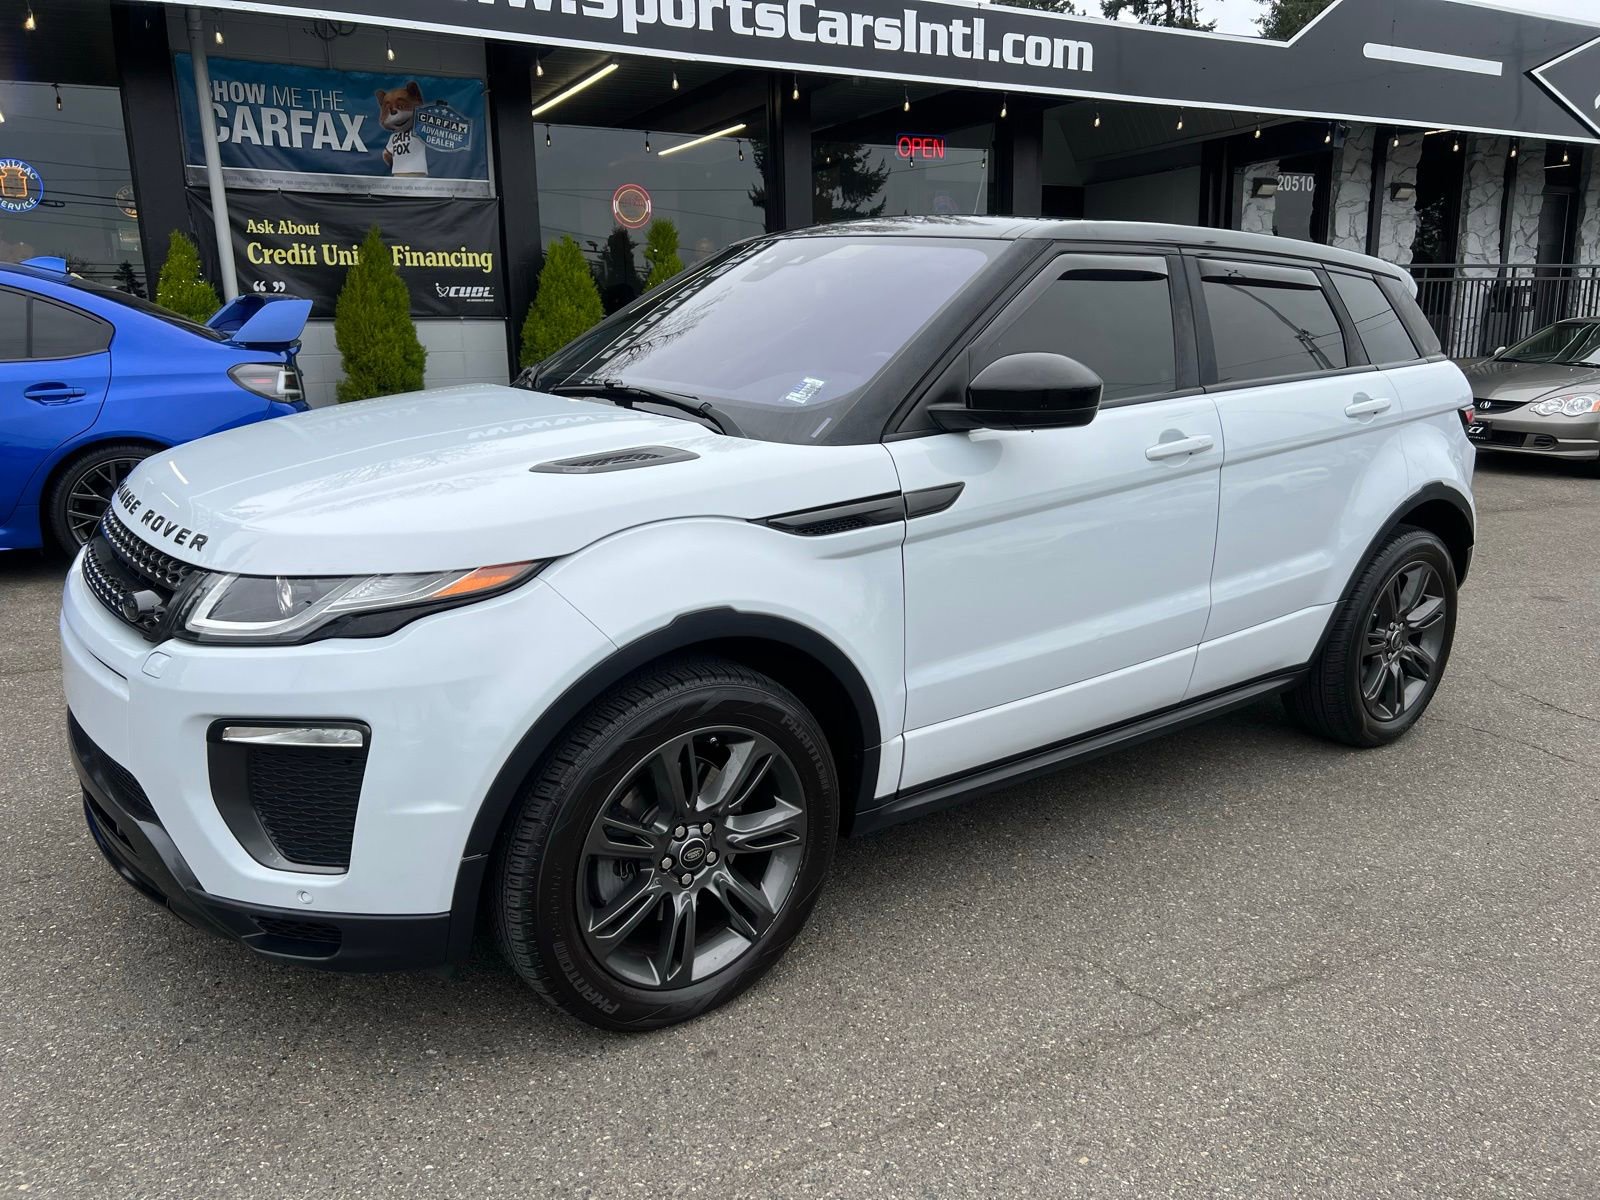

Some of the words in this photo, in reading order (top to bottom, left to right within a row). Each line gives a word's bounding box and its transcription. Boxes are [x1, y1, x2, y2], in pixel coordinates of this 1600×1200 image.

[210, 79, 266, 105] HOW
[272, 85, 303, 108] ME
[307, 88, 345, 112] THE
[212, 102, 369, 153] CARFAX
[418, 113, 467, 134] CARFAX
[391, 131, 411, 144] CAR
[421, 125, 463, 142] ADVANTAGE
[426, 135, 455, 149] DEALER
[392, 143, 411, 156] FOX
[898, 136, 945, 159] OPEN
[1276, 175, 1314, 192] 20510
[246, 219, 275, 235] Ask
[277, 220, 321, 236] About
[246, 242, 318, 266] Credit
[321, 244, 360, 267] Uni
[391, 245, 493, 274] Financing
[448, 286, 495, 298] CUDL
[140, 509, 209, 552] ROVER
